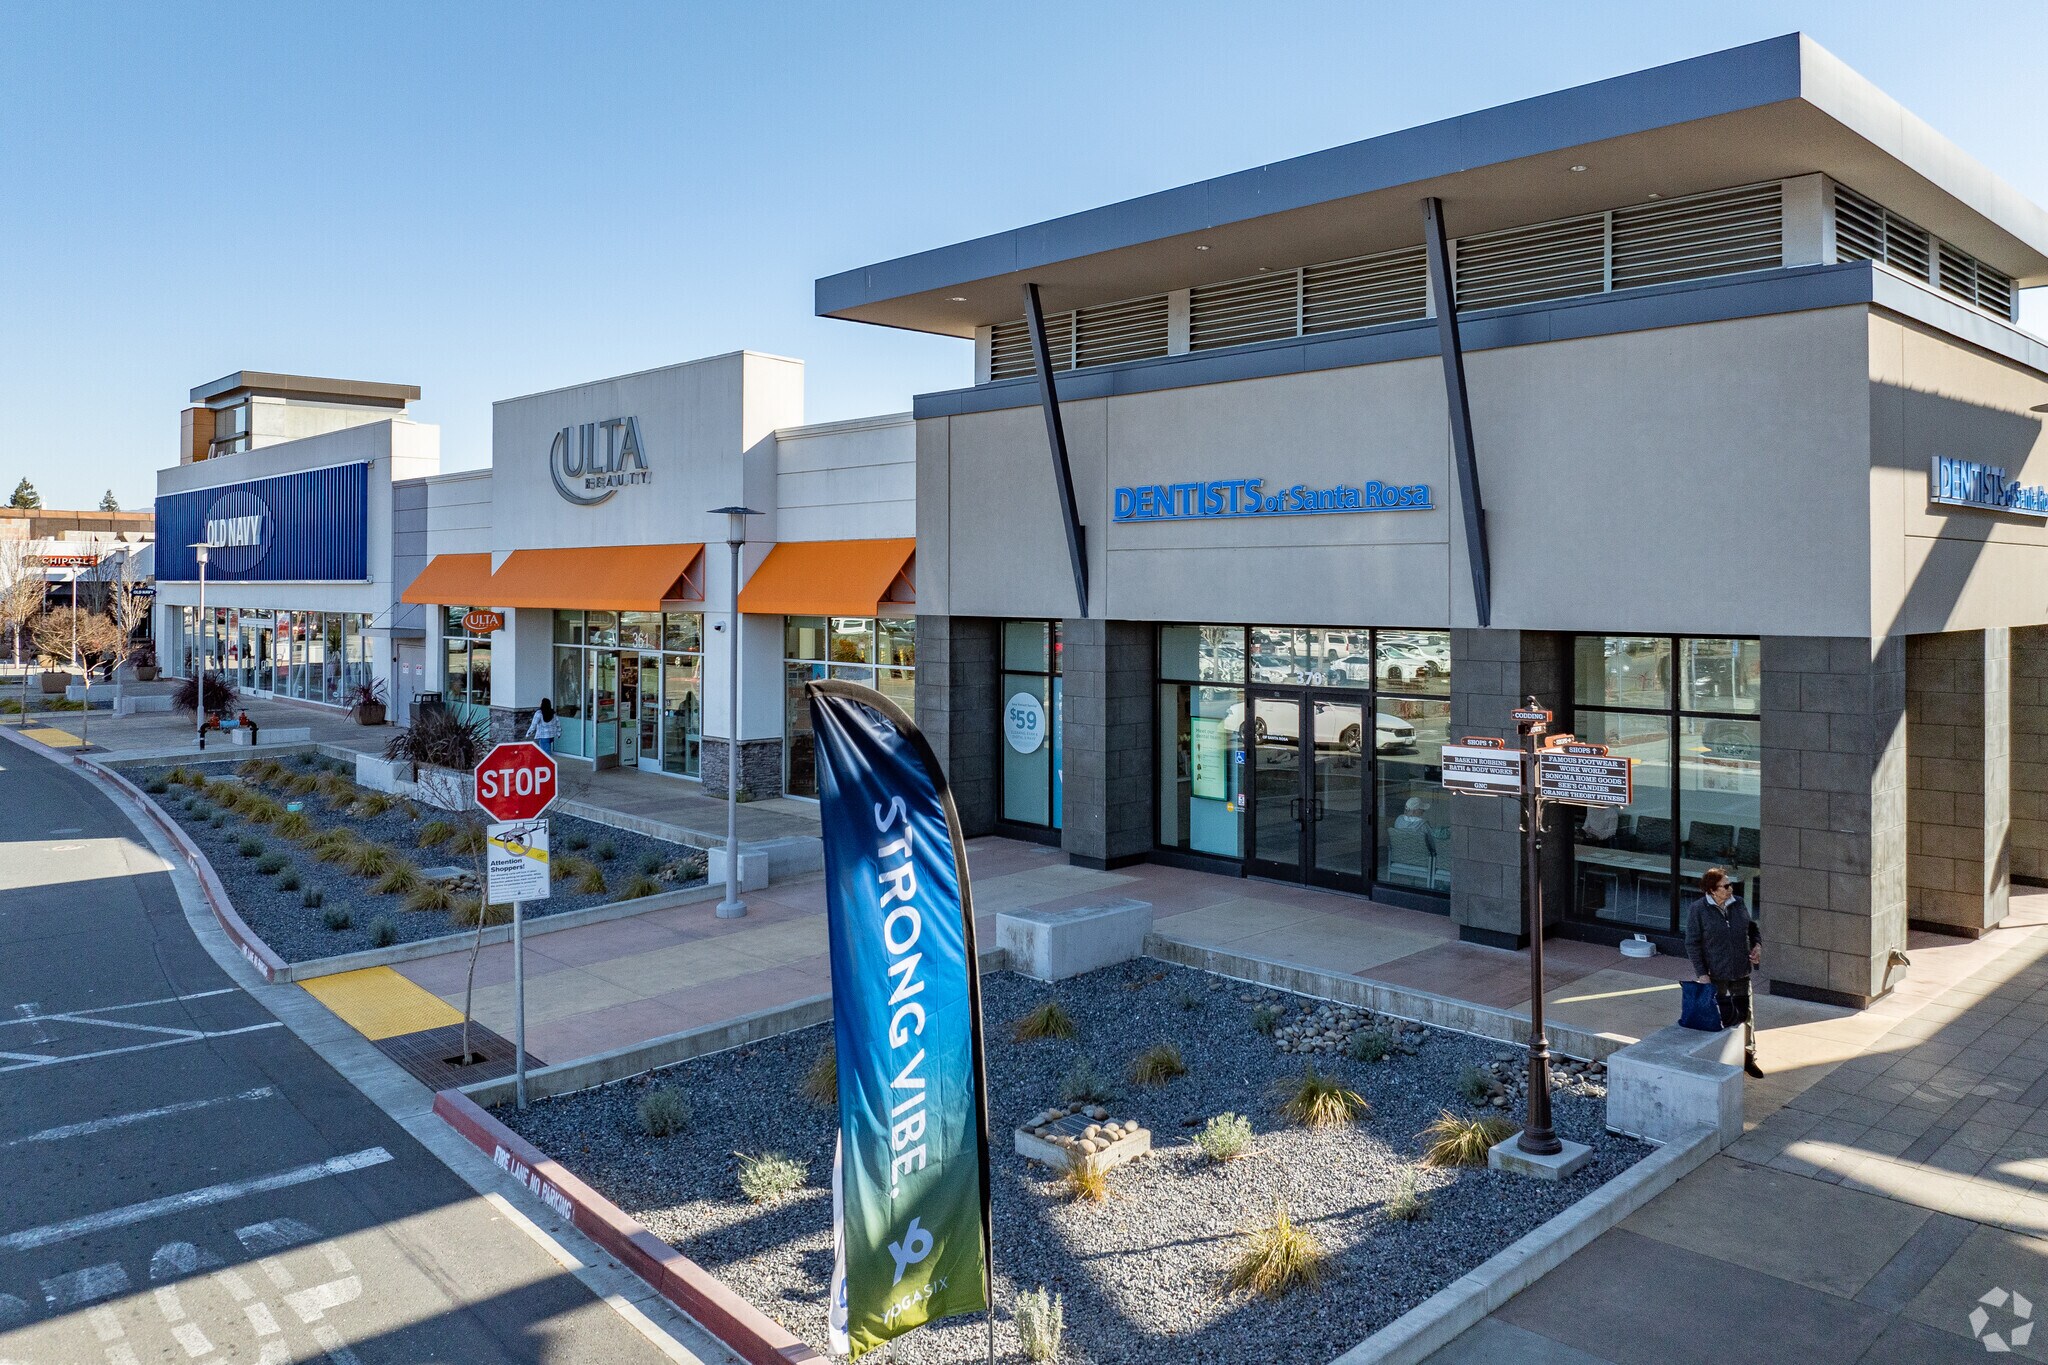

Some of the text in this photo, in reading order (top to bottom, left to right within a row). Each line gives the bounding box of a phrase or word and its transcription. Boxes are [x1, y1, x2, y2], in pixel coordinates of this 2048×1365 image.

[563, 416, 648, 478] ULTA
[585, 472, 652, 489] BEAUTY
[1114, 478, 1430, 518] DENTISTS of Santa Rosa
[207, 515, 261, 547] OLD NAVY
[470, 615, 498, 625] ULTA
[632, 632, 649, 648] 361
[1010, 707, 1037, 730] $59
[1578, 758, 1618, 767] FOOTWEAR
[481, 766, 551, 798] STOP
[1545, 773, 1574, 781] SONOMA
[1543, 789, 1569, 797] ORANGE
[1578, 784, 1609, 792] CANDIES
[490, 858, 523, 866] Attention
[490, 863, 525, 872] Shoppers!
[875, 796, 926, 1199] STRONG VIBE.
[494, 1144, 572, 1220] FIRE LANE NO PARKING
